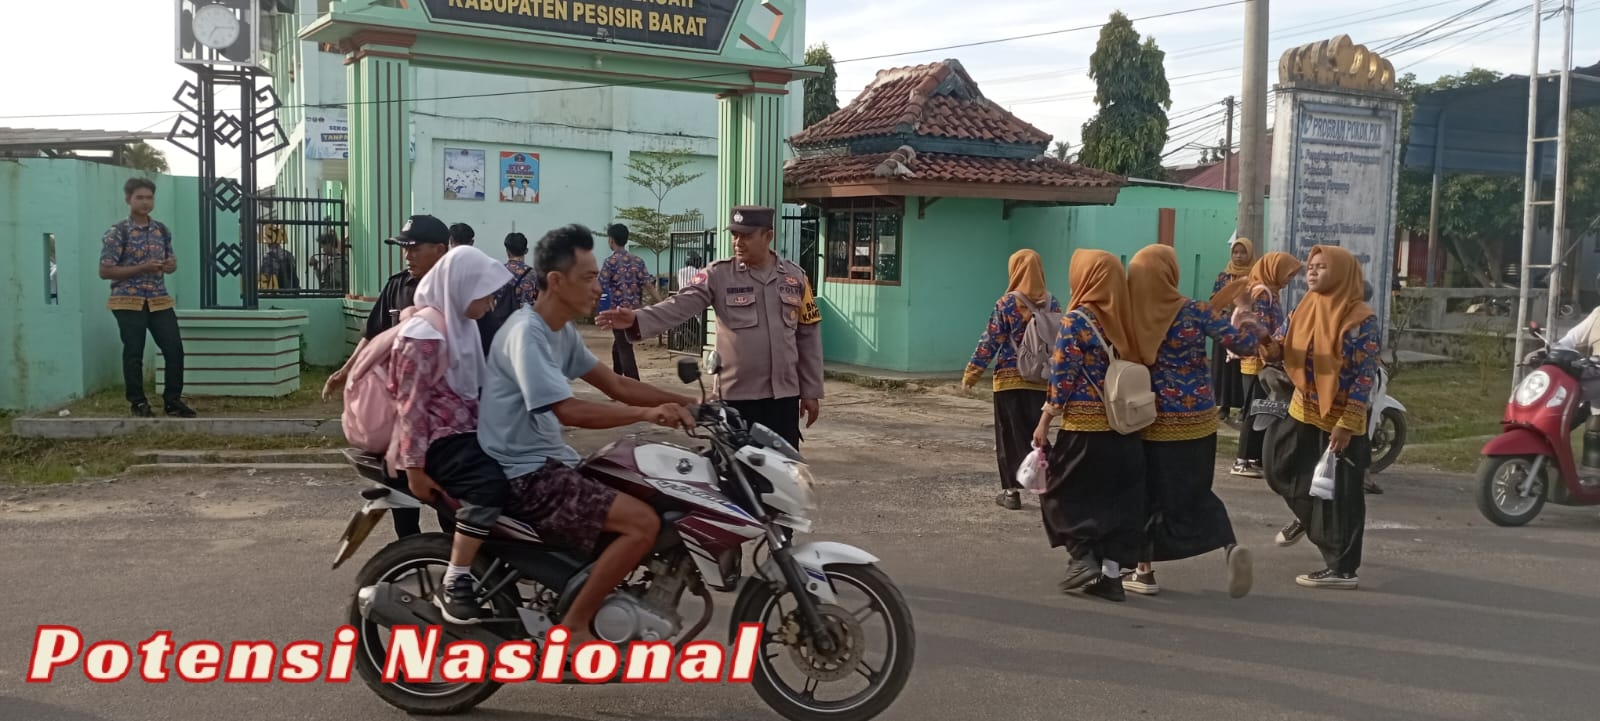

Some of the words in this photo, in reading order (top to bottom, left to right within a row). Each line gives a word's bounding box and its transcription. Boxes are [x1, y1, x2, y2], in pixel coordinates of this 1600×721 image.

[573, 2, 643, 30] PESISIR
[648, 11, 707, 36] BARAT
[1313, 117, 1346, 141] PROGRAM
